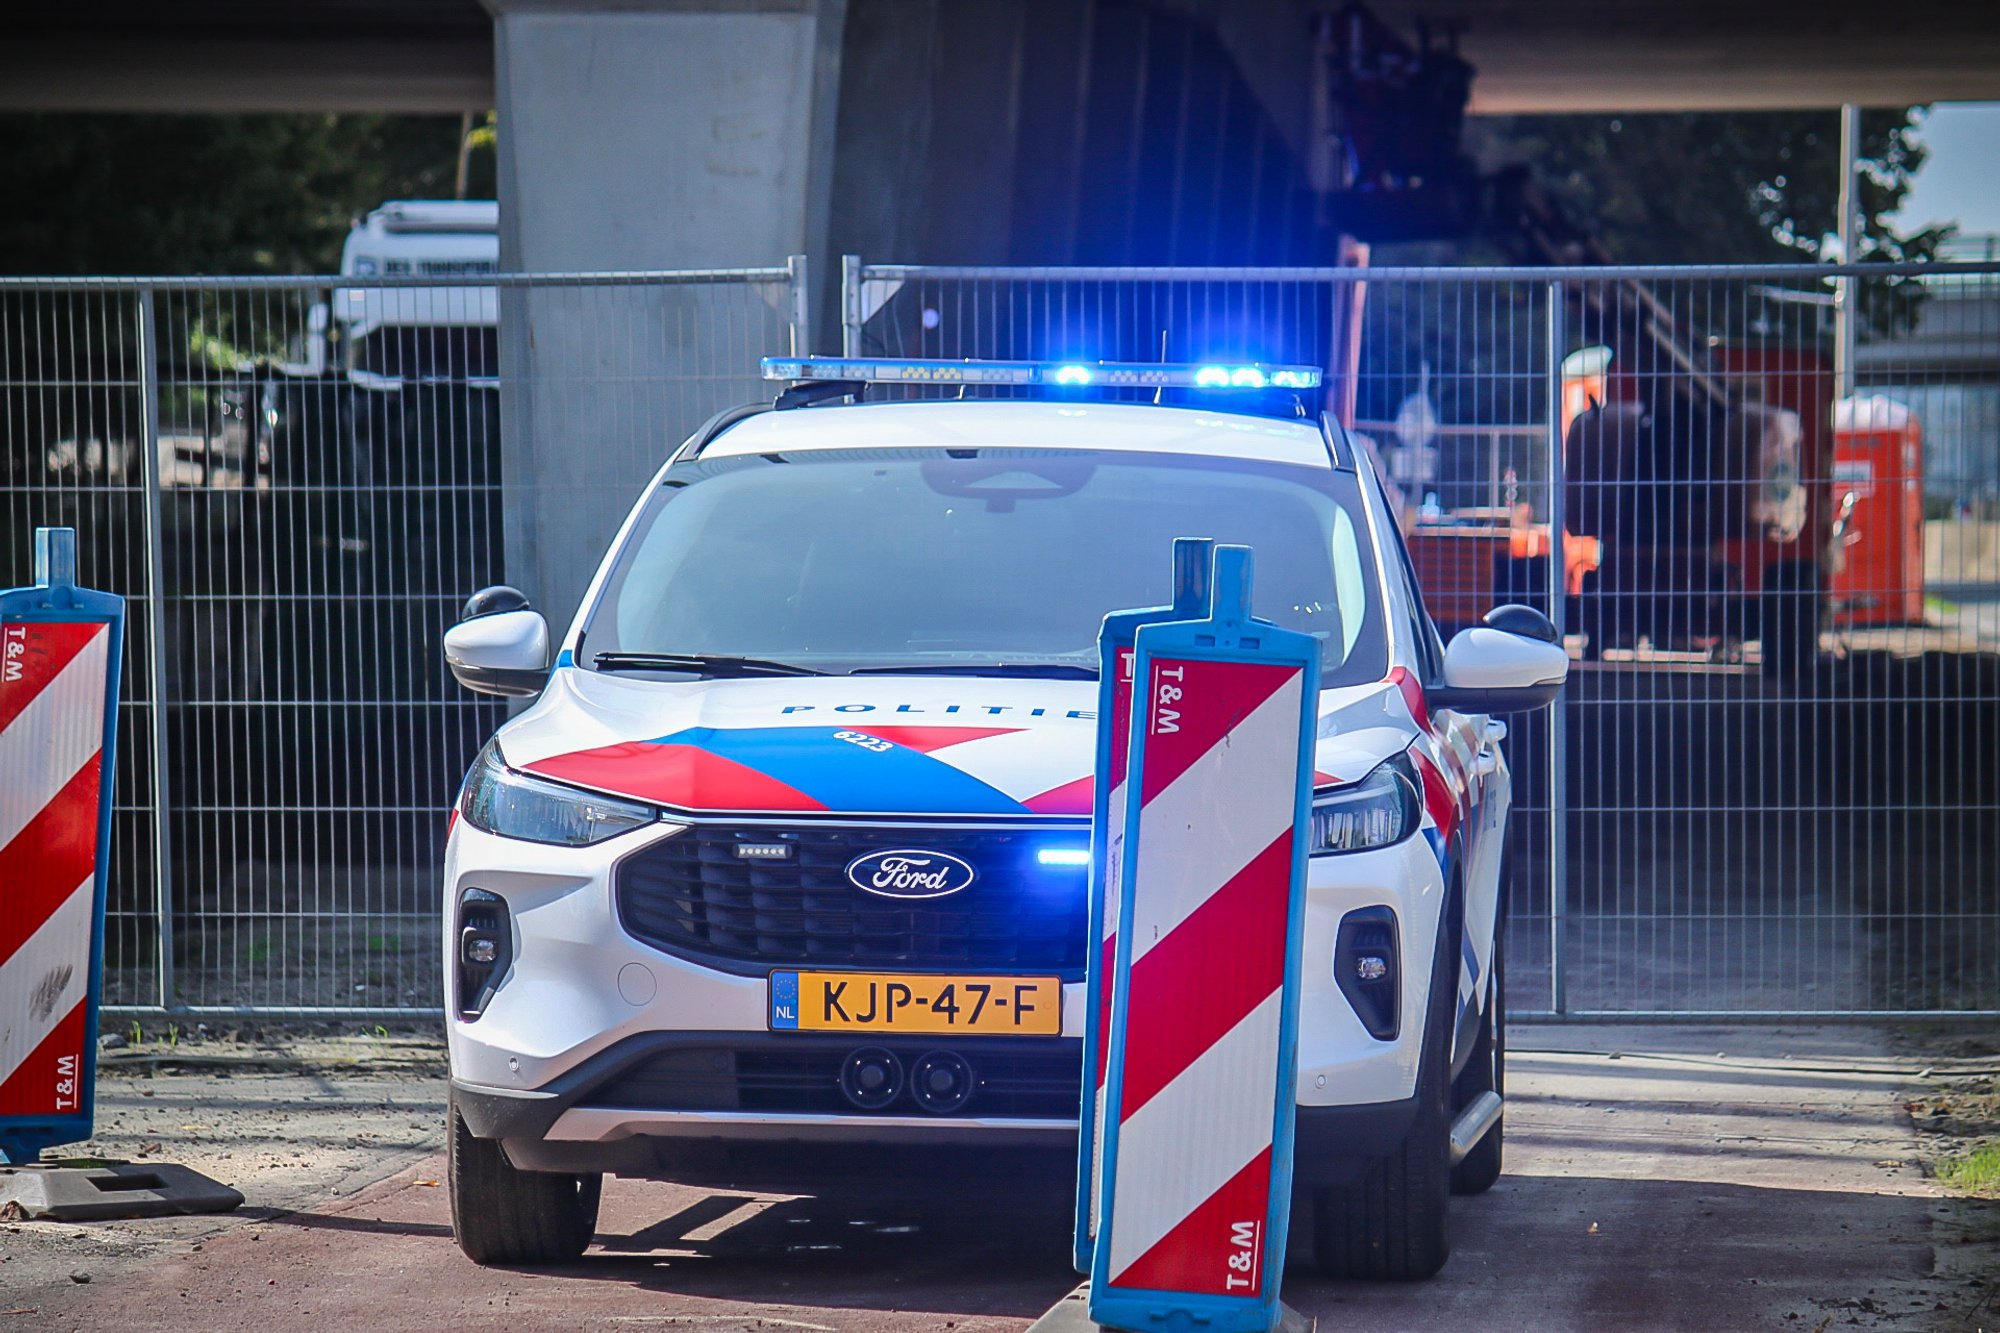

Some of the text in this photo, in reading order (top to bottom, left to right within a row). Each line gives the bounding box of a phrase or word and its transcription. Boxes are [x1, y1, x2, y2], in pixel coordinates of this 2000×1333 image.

[6, 626, 26, 682] T&M
[781, 704, 1097, 721] POLITIE
[1157, 665, 1184, 734] T&M
[833, 731, 894, 752] 6223
[872, 857, 949, 889] Ford
[775, 1006, 795, 1019] NL
[823, 981, 1038, 1025] KJP-47-F
[56, 1055, 75, 1110] T&M
[1226, 1221, 1254, 1291] T&M
